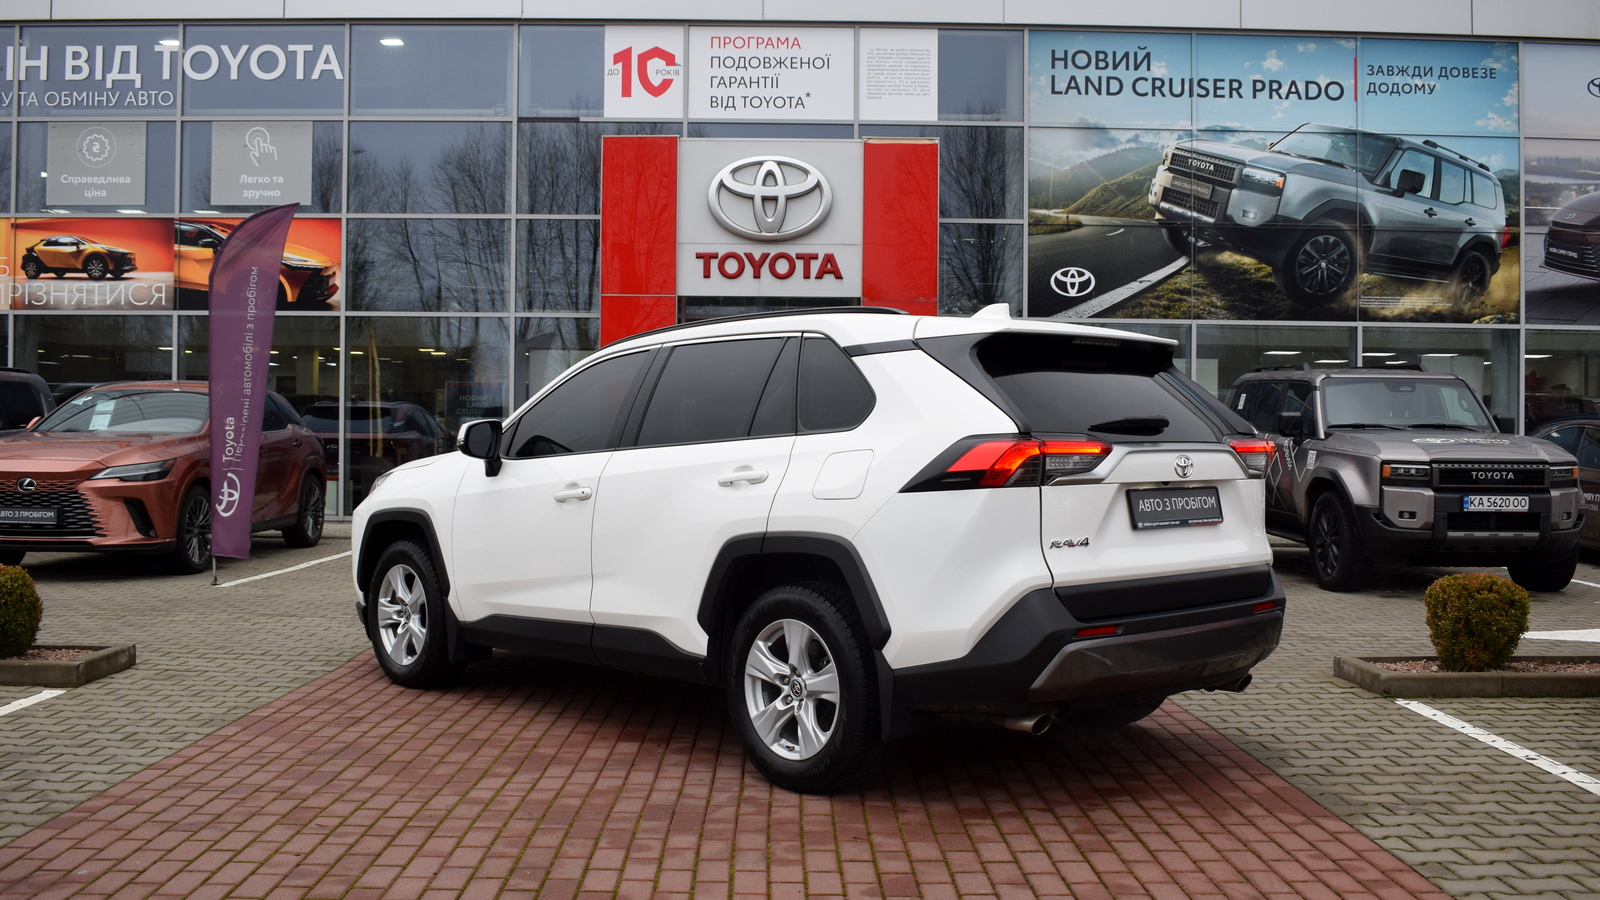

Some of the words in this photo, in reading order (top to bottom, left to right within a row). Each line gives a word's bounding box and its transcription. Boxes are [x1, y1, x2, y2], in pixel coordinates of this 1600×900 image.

[709, 36, 802, 50] ПРОГРАМА
[0, 45, 49, 81] ІН
[64, 44, 142, 89] ВІД
[153, 43, 345, 81] TOYOTA
[709, 53, 832, 72] ПОДОВЖЕНОЇ
[1050, 46, 1152, 72] НОВИЙ
[606, 68, 620, 77] ДО
[655, 68, 681, 77] РОКІВ
[1366, 64, 1434, 80] ЗАВЖДИ
[1437, 66, 1497, 80] ДОВЕЗЕ
[709, 73, 781, 89] ГАРАНТІЇ
[1050, 74, 1124, 97] LAND
[1131, 76, 1244, 100] CRUISER
[1251, 79, 1345, 102] PRADO
[1366, 82, 1437, 96] ДОДОМУ
[20, 91, 39, 107] ТА
[44, 90, 121, 107] ОБМІНУ
[124, 90, 174, 106] АВТО
[709, 95, 737, 111] ВІД
[1188, 159, 1214, 171] TOYOTA
[60, 173, 132, 186] Справедлива
[239, 174, 270, 184] Легко
[272, 176, 284, 184] та
[84, 188, 107, 198] ціна
[242, 189, 281, 199] зручно
[695, 251, 844, 280] TOYOTA
[246, 266, 259, 320] пробігом
[242, 332, 254, 395] автомобілі
[222, 416, 237, 462] Toyota
[1471, 471, 1515, 479] TOYOTA
[1138, 498, 1163, 512] АВТО
[1164, 498, 1171, 511] З
[1171, 496, 1217, 510] ПРОБІГОМ
[1469, 497, 1485, 508] KA
[1487, 497, 1511, 508] 5620
[1049, 536, 1090, 550] RAV4
